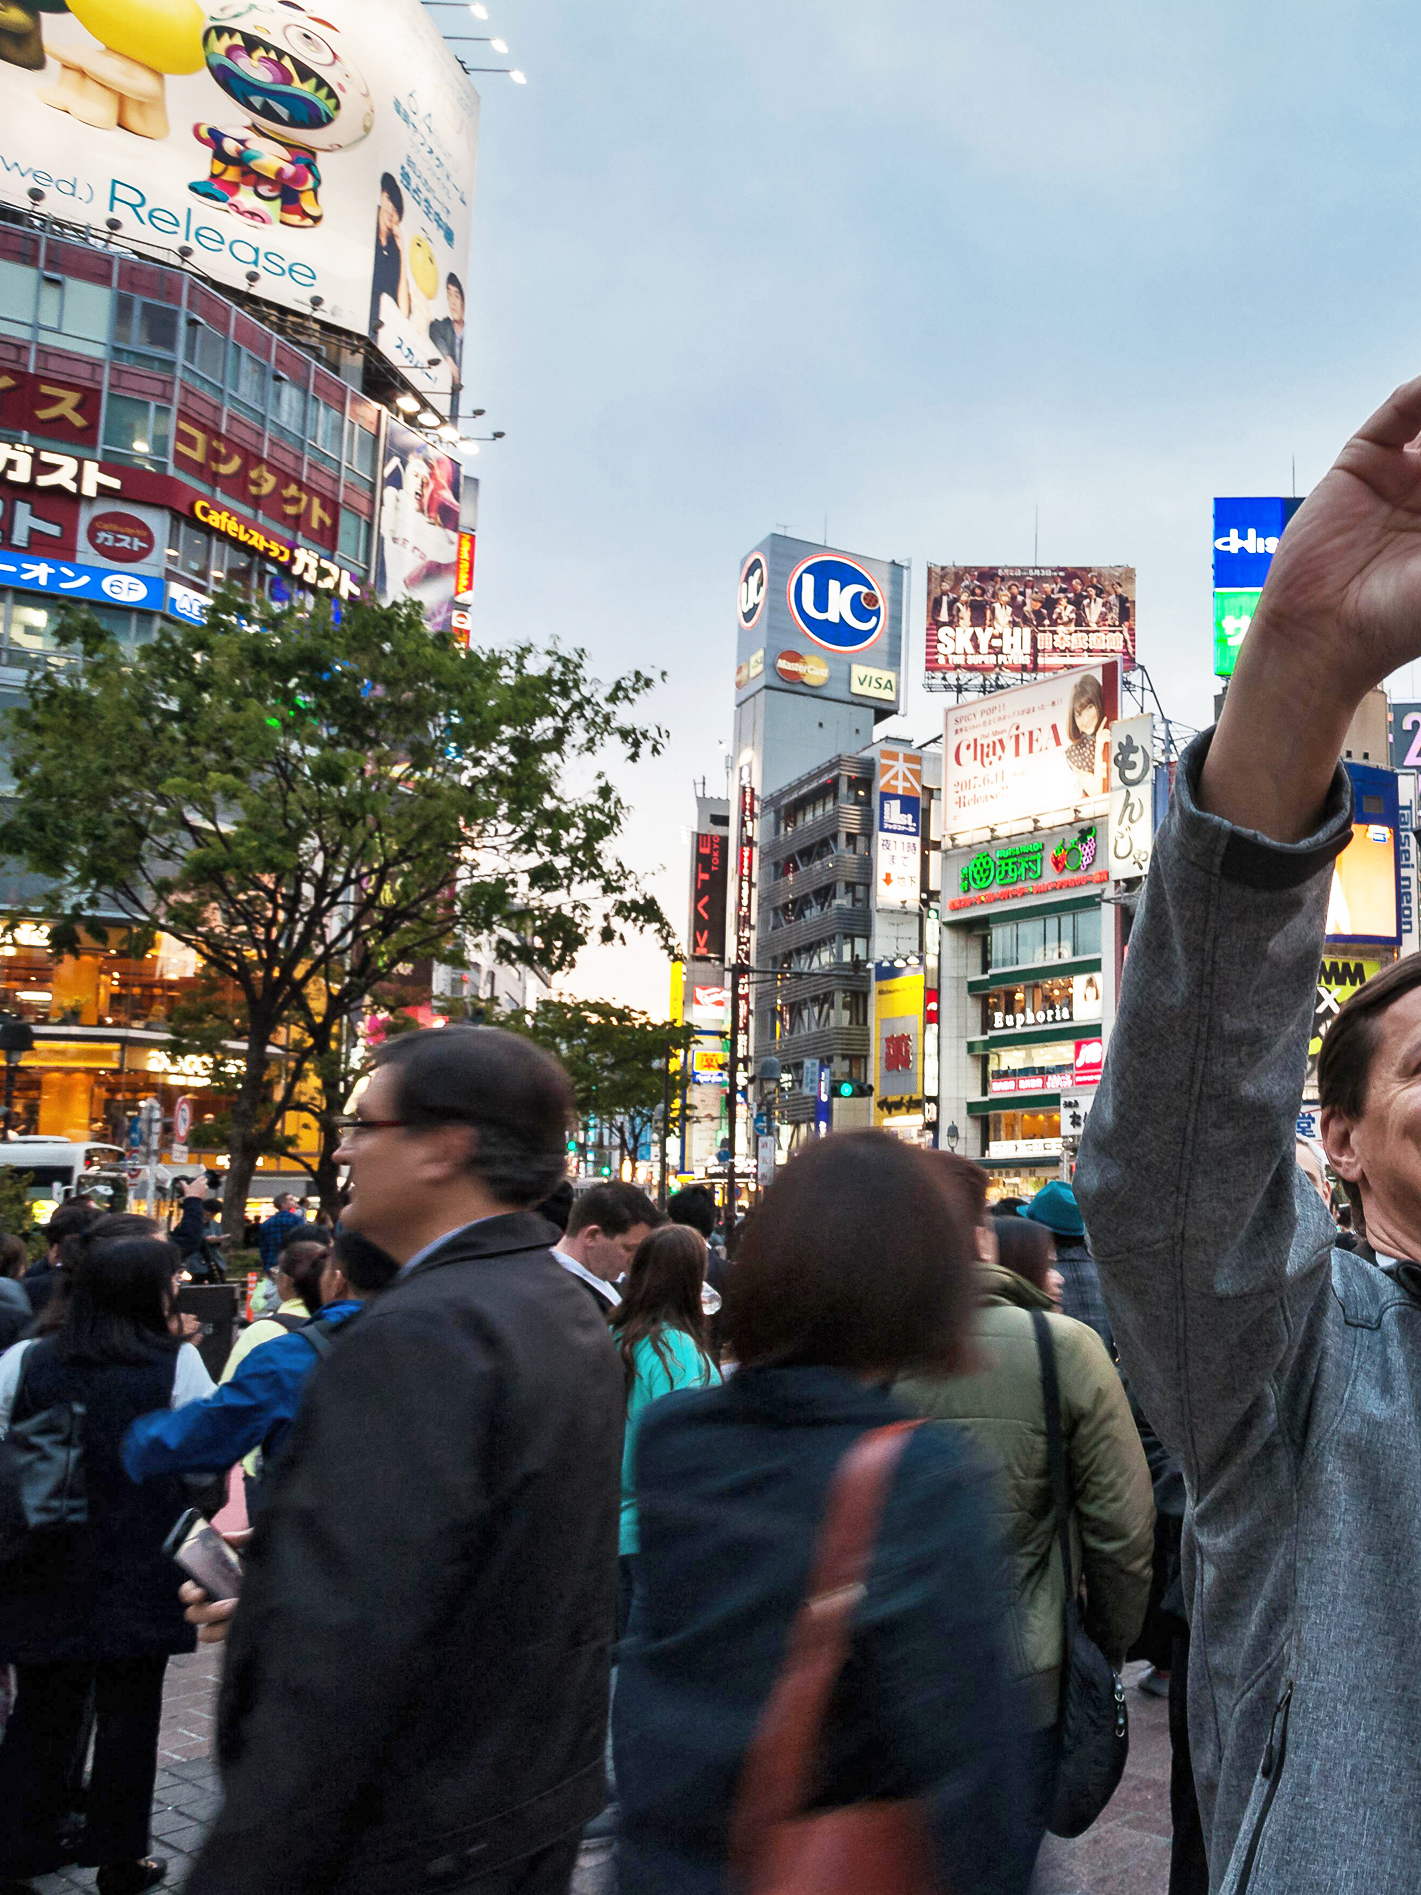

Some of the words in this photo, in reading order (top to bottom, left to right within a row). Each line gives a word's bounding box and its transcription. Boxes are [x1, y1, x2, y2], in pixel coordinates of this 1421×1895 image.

[108, 178, 318, 288] Release
[175, 420, 332, 530] コンタクト
[109, 578, 140, 597] 6F
[801, 573, 878, 631] UC
[936, 625, 1031, 655] SKY-HI
[856, 674, 894, 693] VISA
[954, 712, 977, 726] SPICY
[1113, 734, 1151, 871] もんじゃ
[996, 853, 1043, 885] 西村
[1401, 876, 1413, 934] neon
[993, 1003, 1071, 1030] Euphoria
